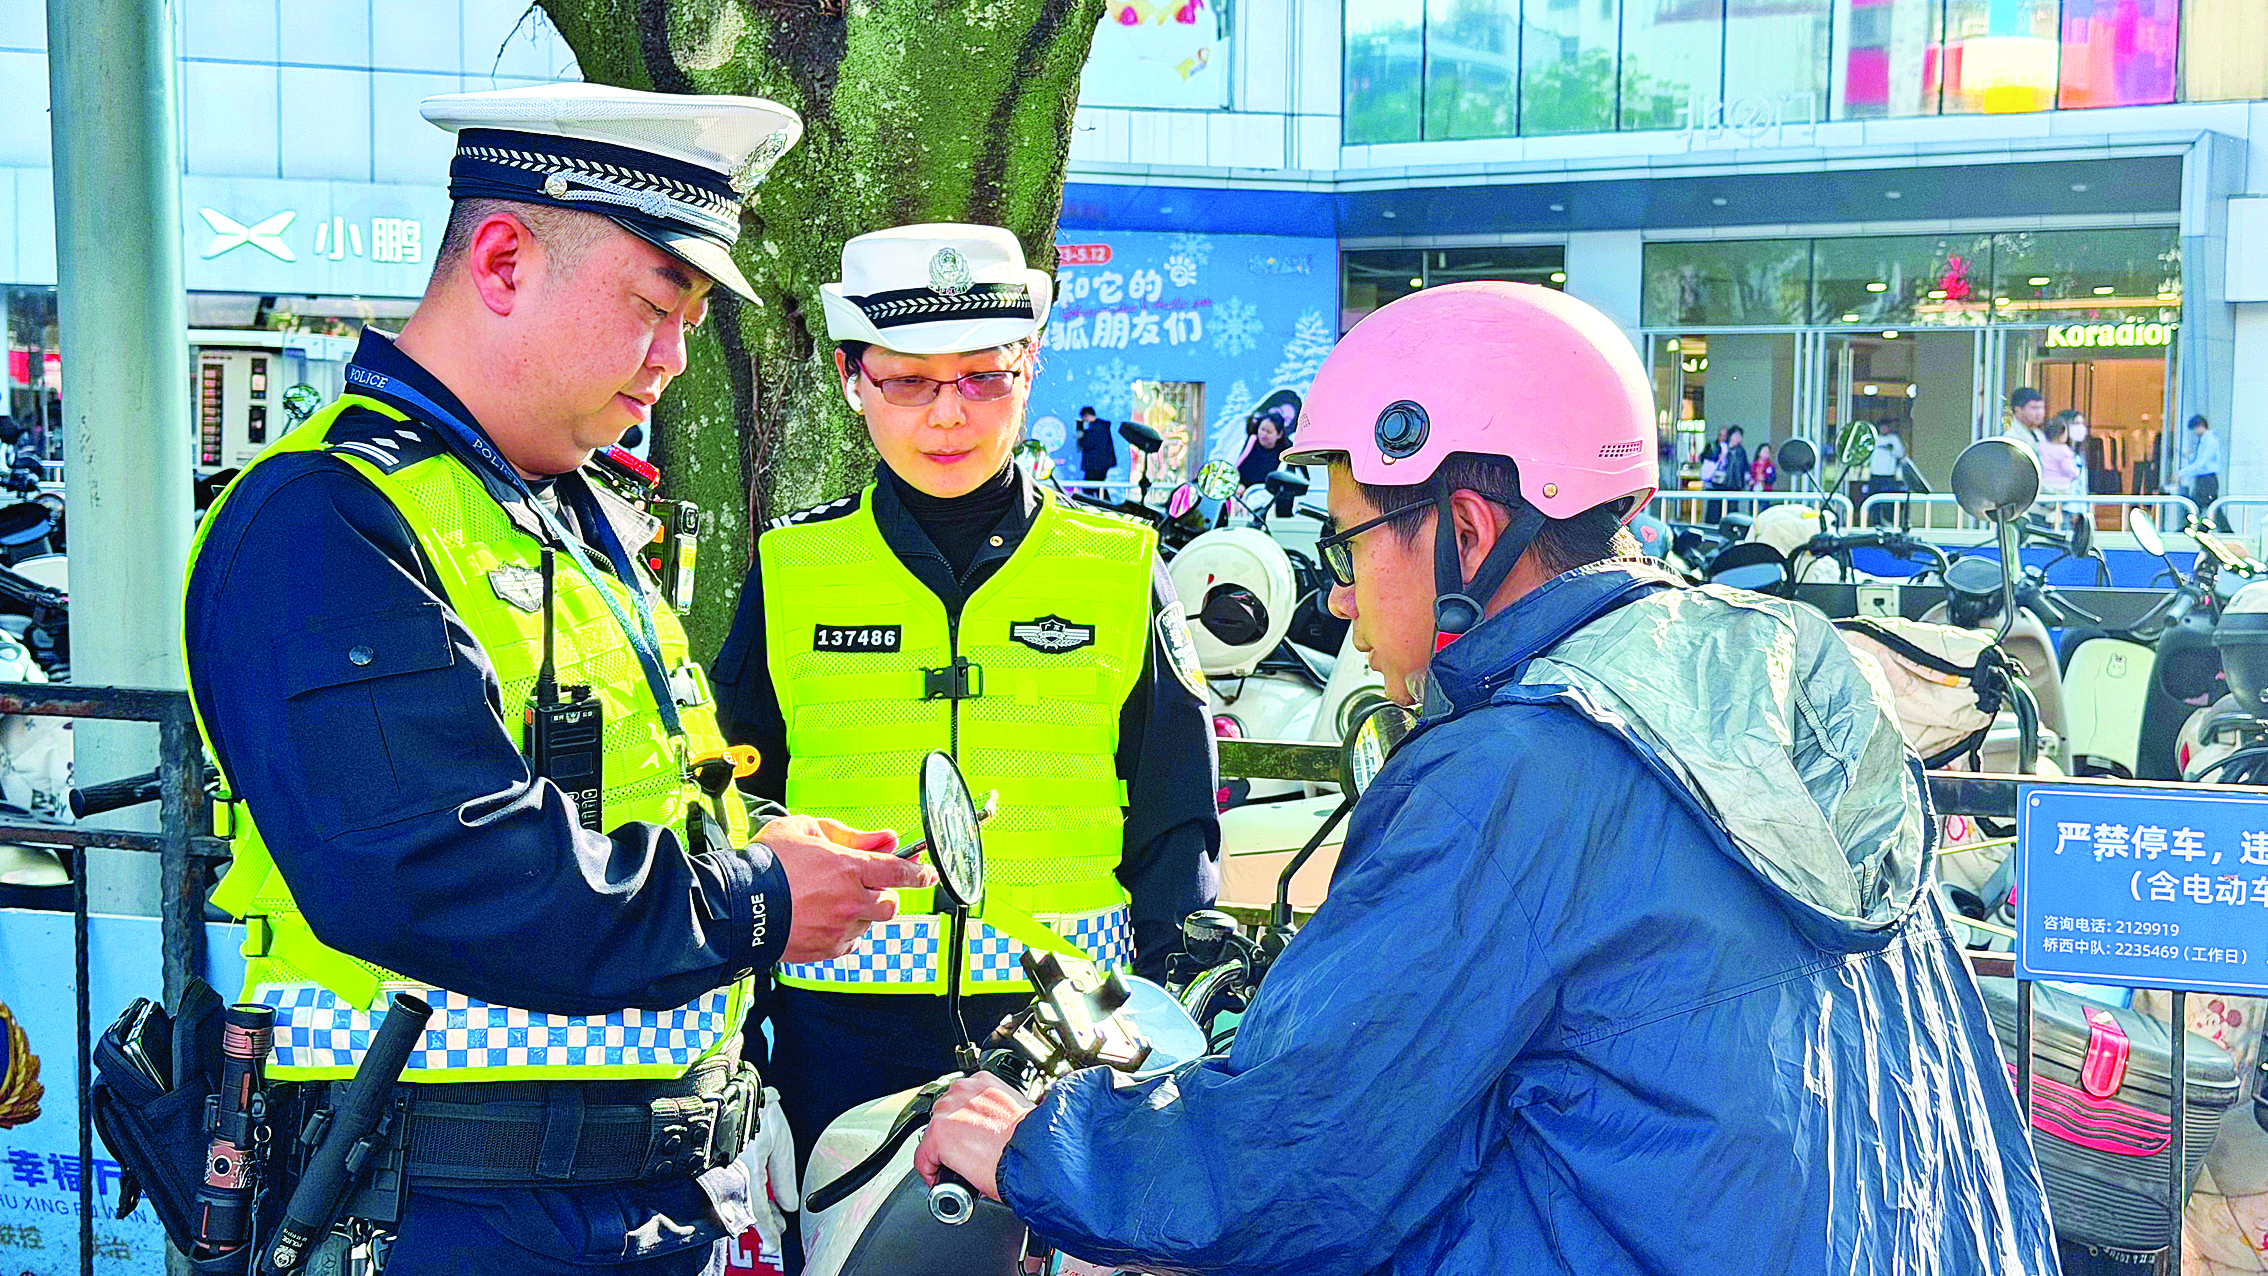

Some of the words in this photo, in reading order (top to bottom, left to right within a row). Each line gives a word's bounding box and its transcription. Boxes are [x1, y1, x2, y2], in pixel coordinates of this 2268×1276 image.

[314, 215, 421, 263] 小鹏
[1042, 311, 1202, 351] 狐朋友们
[350, 367, 388, 389] POLICE
[817, 629, 896, 647] 137486
[750, 892, 767, 947] POLICE
[7, 1149, 148, 1198] 幸福万
[22, 1196, 69, 1216] XING
[102, 1204, 147, 1224] WN
